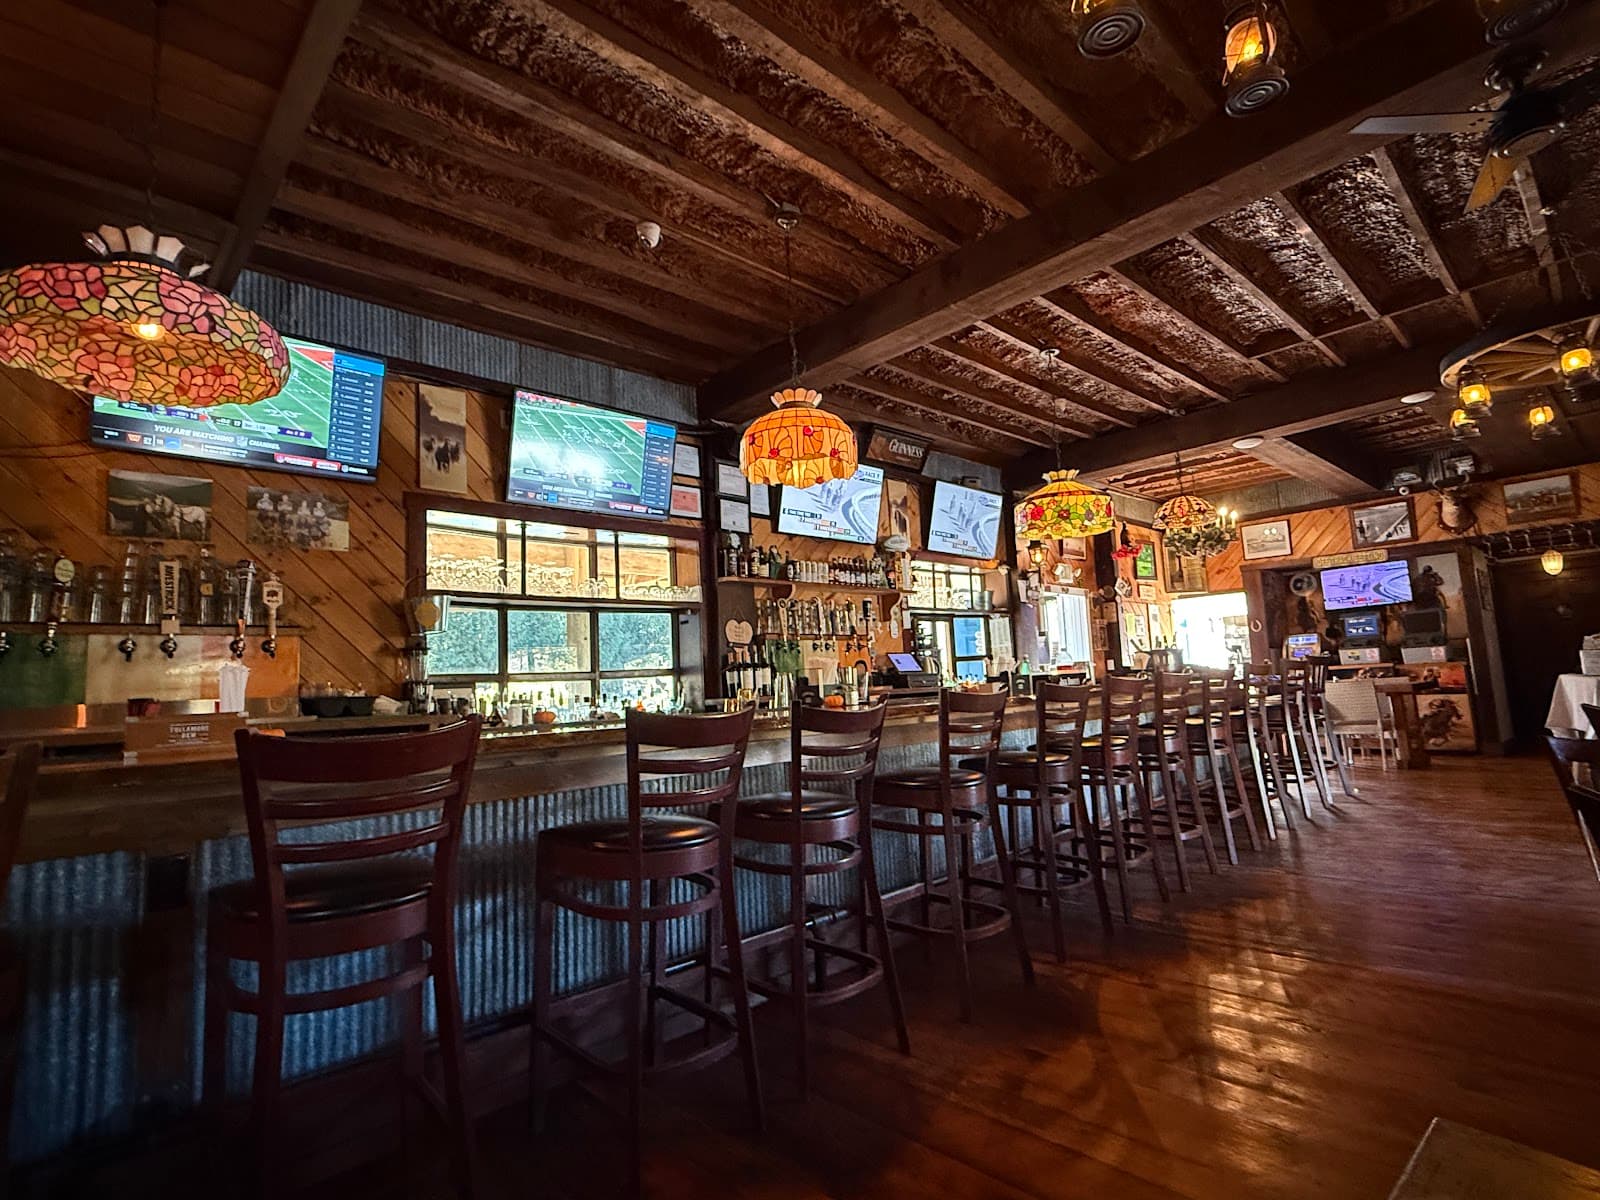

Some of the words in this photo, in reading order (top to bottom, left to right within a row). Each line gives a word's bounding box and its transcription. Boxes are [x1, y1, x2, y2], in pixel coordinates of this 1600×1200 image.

[154, 424, 174, 434] YOU
[173, 427, 192, 436] ARE
[192, 429, 234, 443] WATCHING
[248, 440, 281, 451] CHANNEL
[889, 439, 925, 458] GUINNESS
